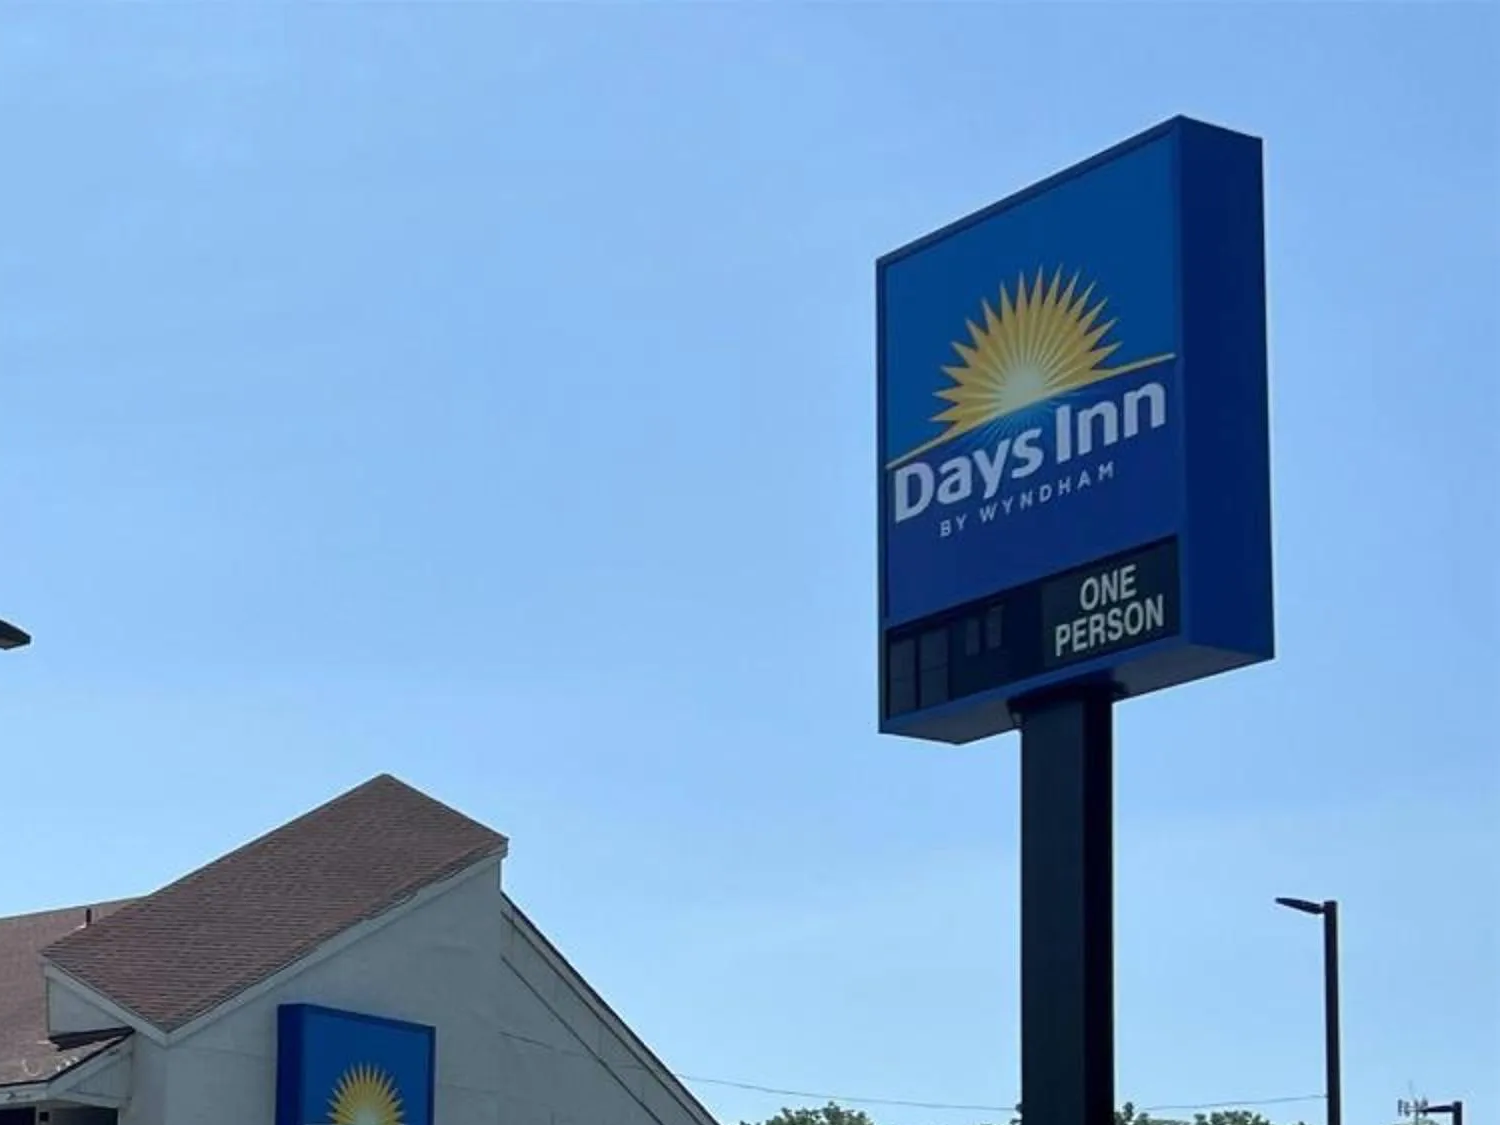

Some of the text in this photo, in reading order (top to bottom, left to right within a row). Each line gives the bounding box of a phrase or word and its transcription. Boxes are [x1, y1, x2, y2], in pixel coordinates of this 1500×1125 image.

[894, 381, 1166, 523] Days Inn
[939, 460, 1115, 538] BY WYNDHAM
[1079, 563, 1138, 611] ONE
[1055, 593, 1165, 657] PERSON
